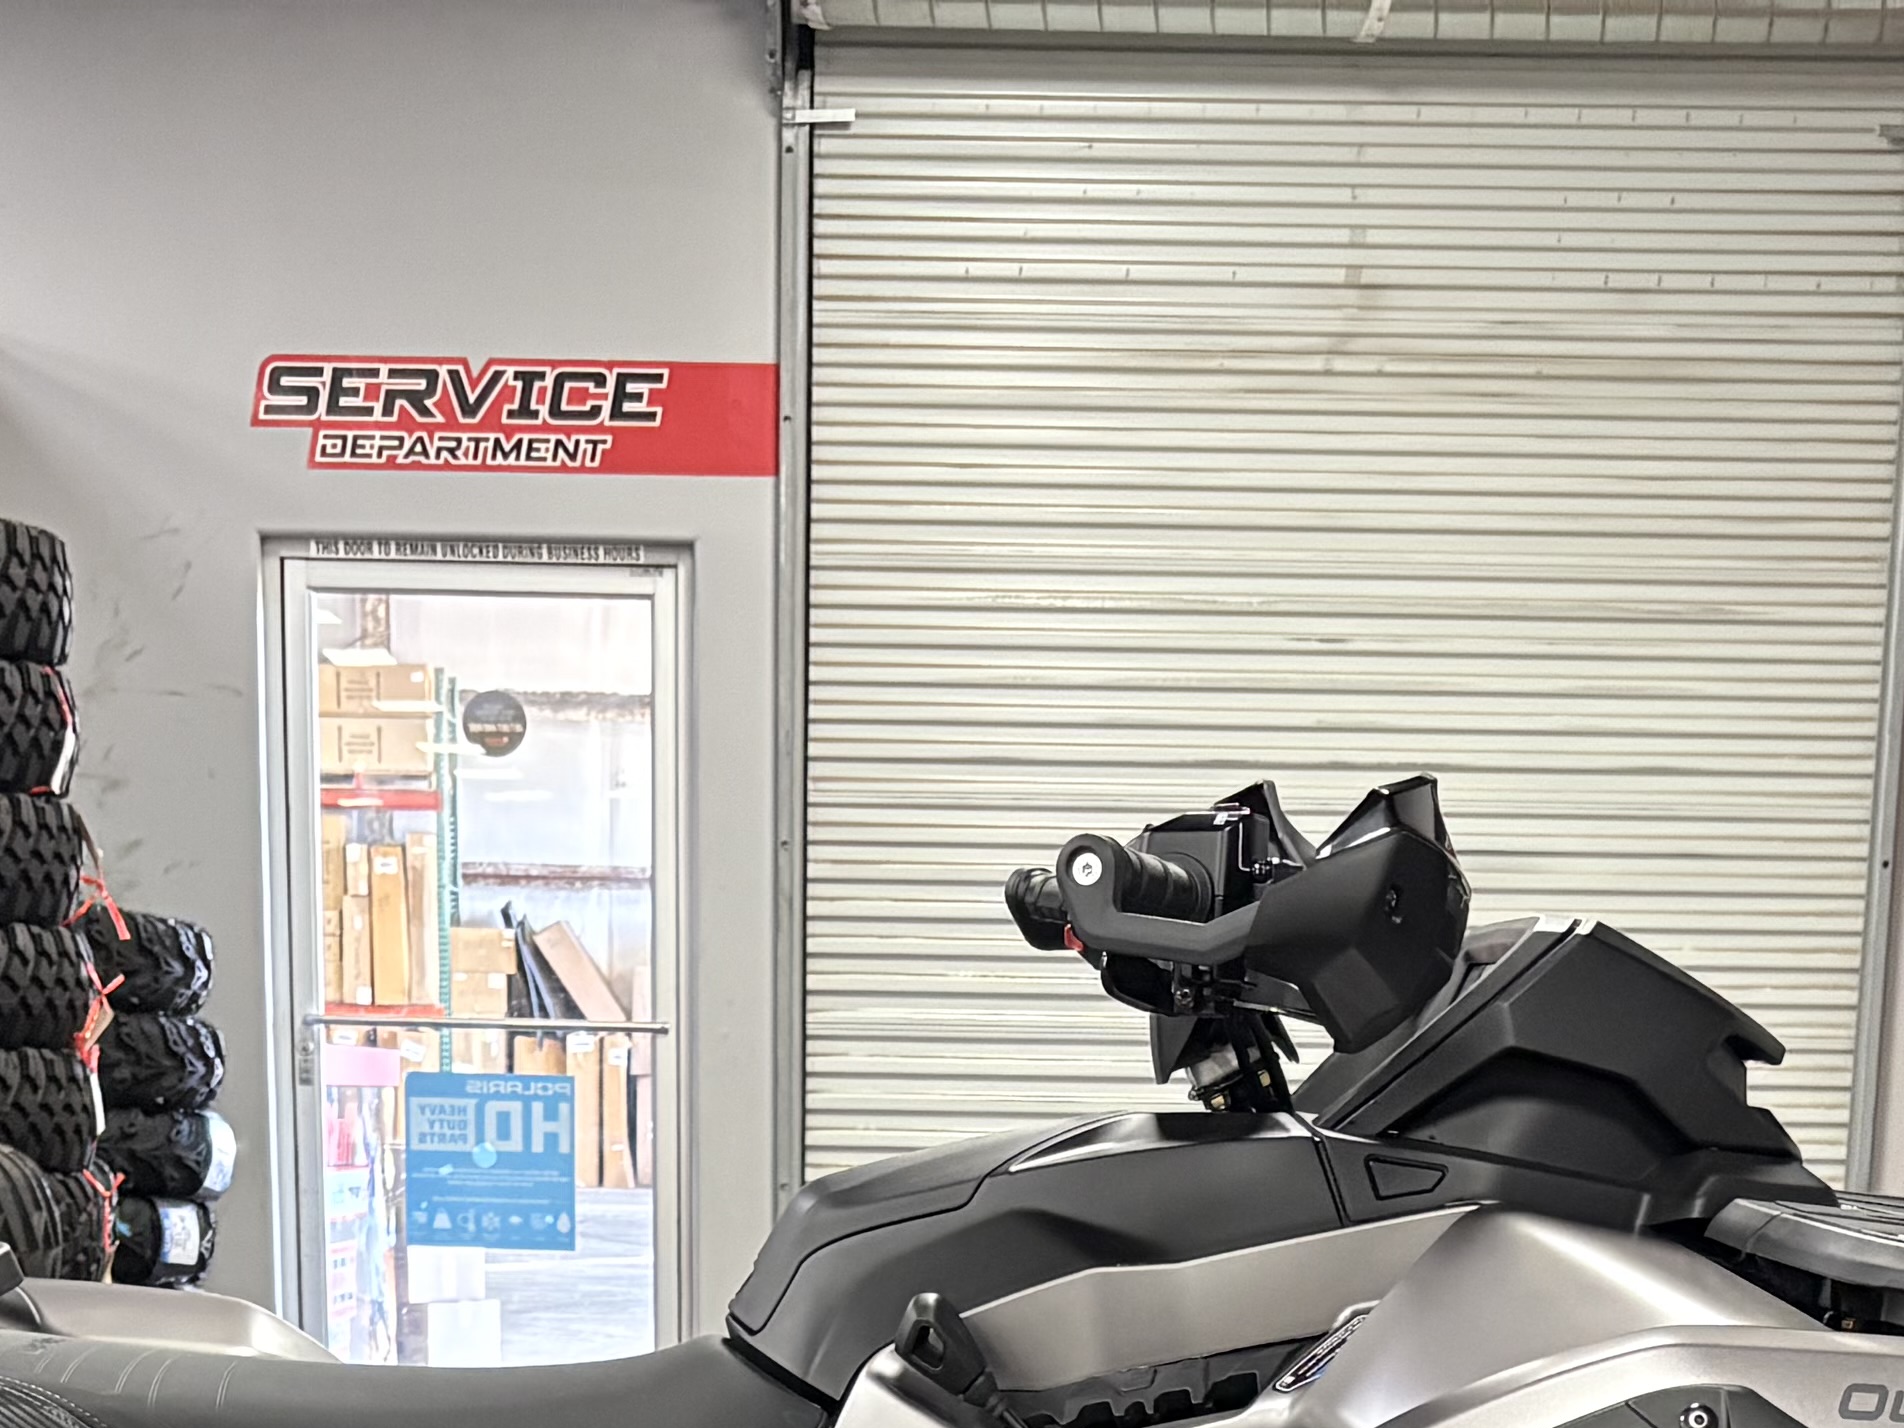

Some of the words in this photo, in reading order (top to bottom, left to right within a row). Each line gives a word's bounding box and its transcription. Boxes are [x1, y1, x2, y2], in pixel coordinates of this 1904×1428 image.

[259, 363, 668, 427] SERVICE
[317, 430, 611, 467] DEPARTMENT
[314, 540, 340, 557] THIS
[345, 540, 374, 557] DOOR
[378, 540, 392, 557] TO
[395, 541, 438, 558] REMAIN
[441, 542, 499, 560] UNLOCKED
[547, 544, 600, 562] BUSINESS
[603, 544, 641, 562] HOURS
